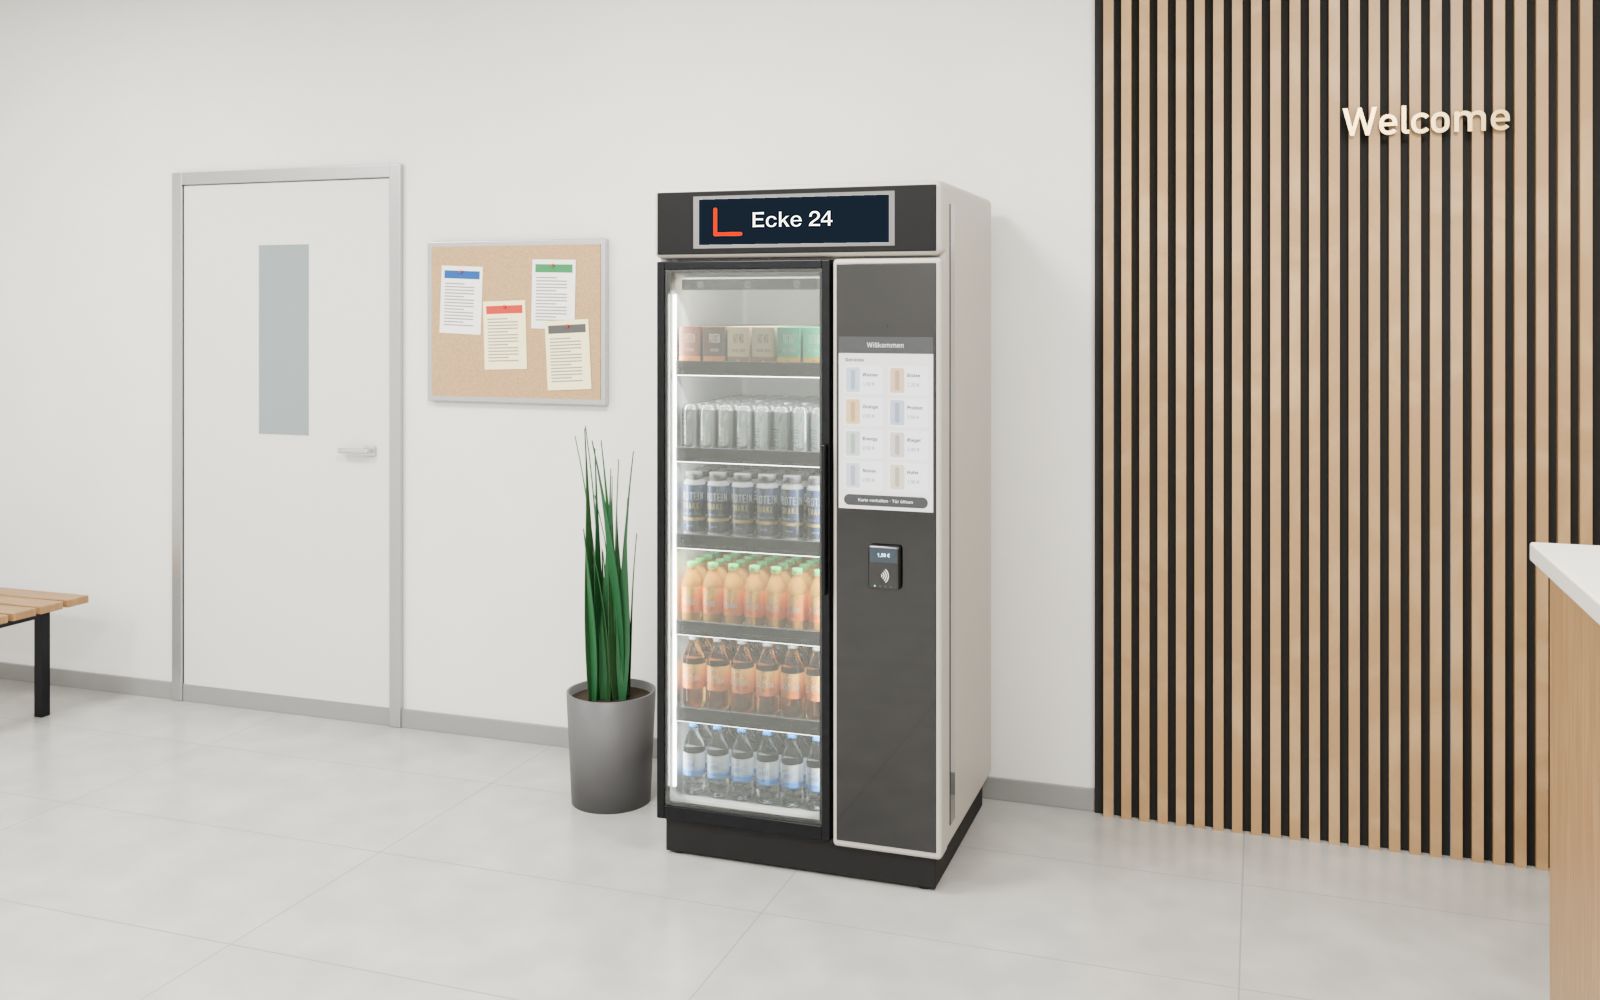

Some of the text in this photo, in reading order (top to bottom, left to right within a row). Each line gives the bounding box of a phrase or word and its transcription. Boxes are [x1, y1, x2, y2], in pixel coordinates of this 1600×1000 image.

[1342, 105, 1511, 137] Welcome
[751, 210, 833, 228] Ecke 24
[866, 341, 905, 349] Willkommen
